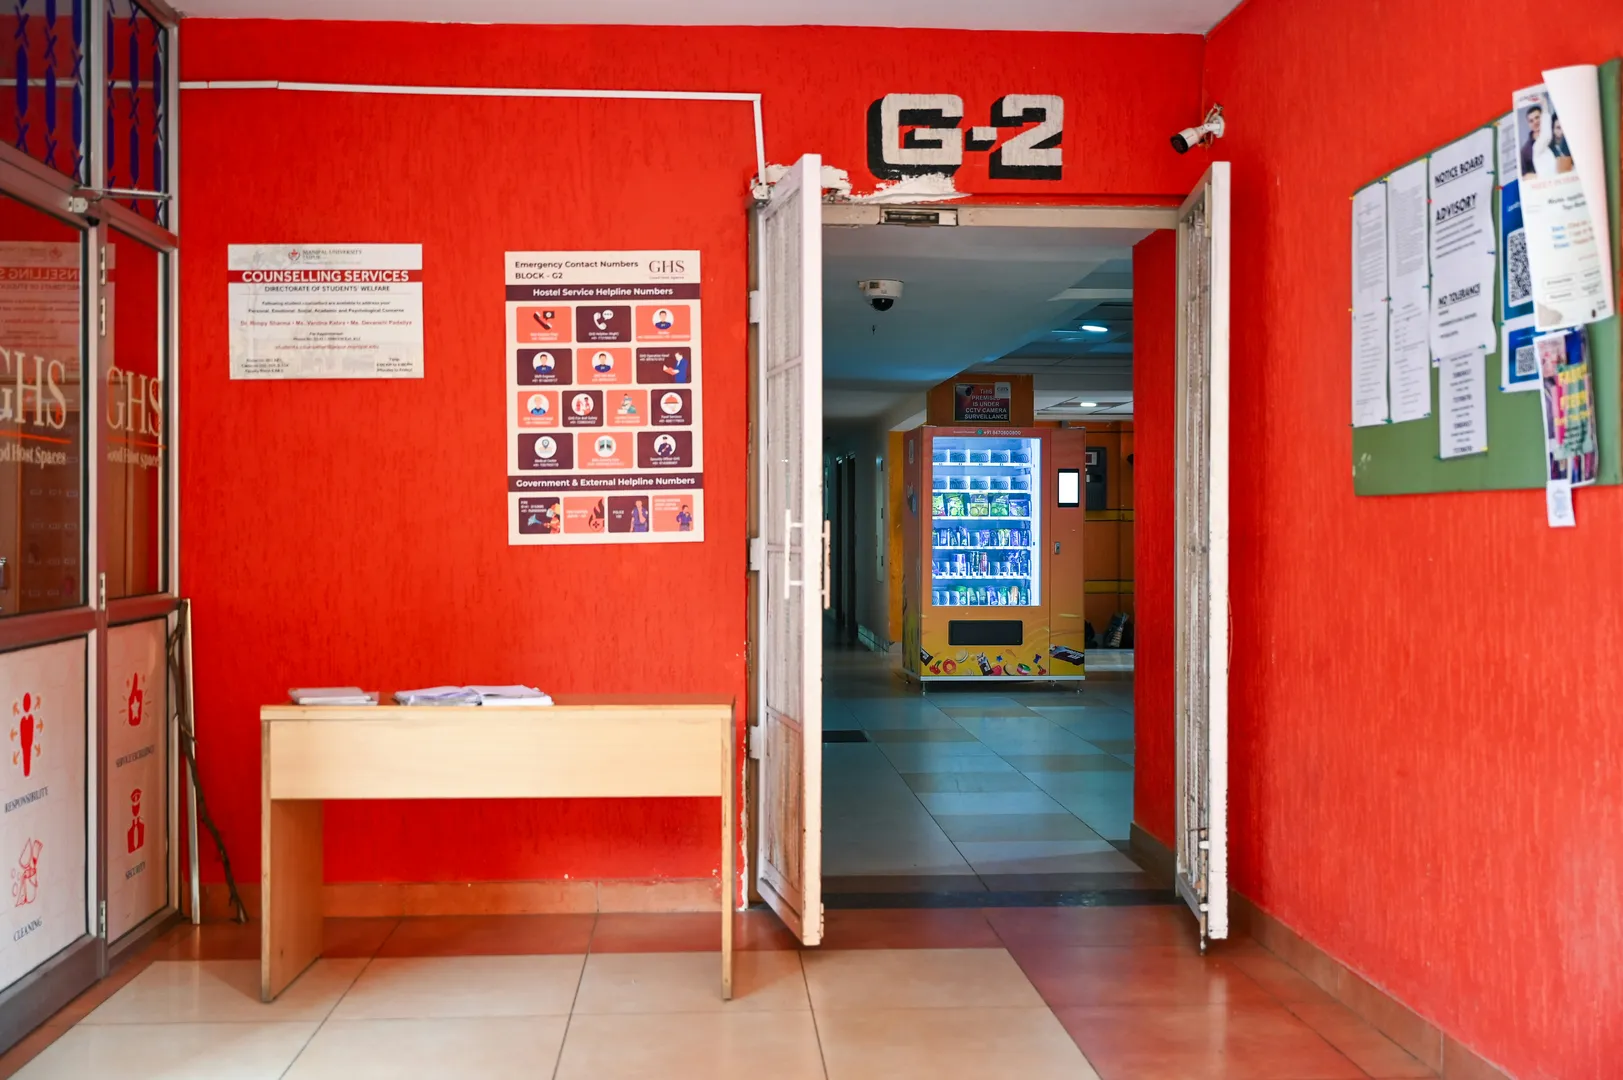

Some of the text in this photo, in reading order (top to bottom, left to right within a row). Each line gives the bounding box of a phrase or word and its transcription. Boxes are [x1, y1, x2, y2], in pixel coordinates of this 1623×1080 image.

[867, 93, 1064, 180] G-2
[1434, 154, 1484, 184] NOTICE BOARD
[1435, 192, 1478, 221] ADVISORY
[241, 270, 410, 283] COUNSELLING SERVICES
[515, 261, 563, 269] Emergency
[600, 260, 639, 268] Numbers
[648, 259, 685, 273] GHS
[532, 287, 673, 297] Hostel Service Helpline Numbers
[106, 366, 162, 437] GHS
[516, 477, 695, 488] Government & External Helpline Numbers
[4, 786, 50, 814] RESPONSIBILITY
[13, 917, 43, 942] CLEANING
